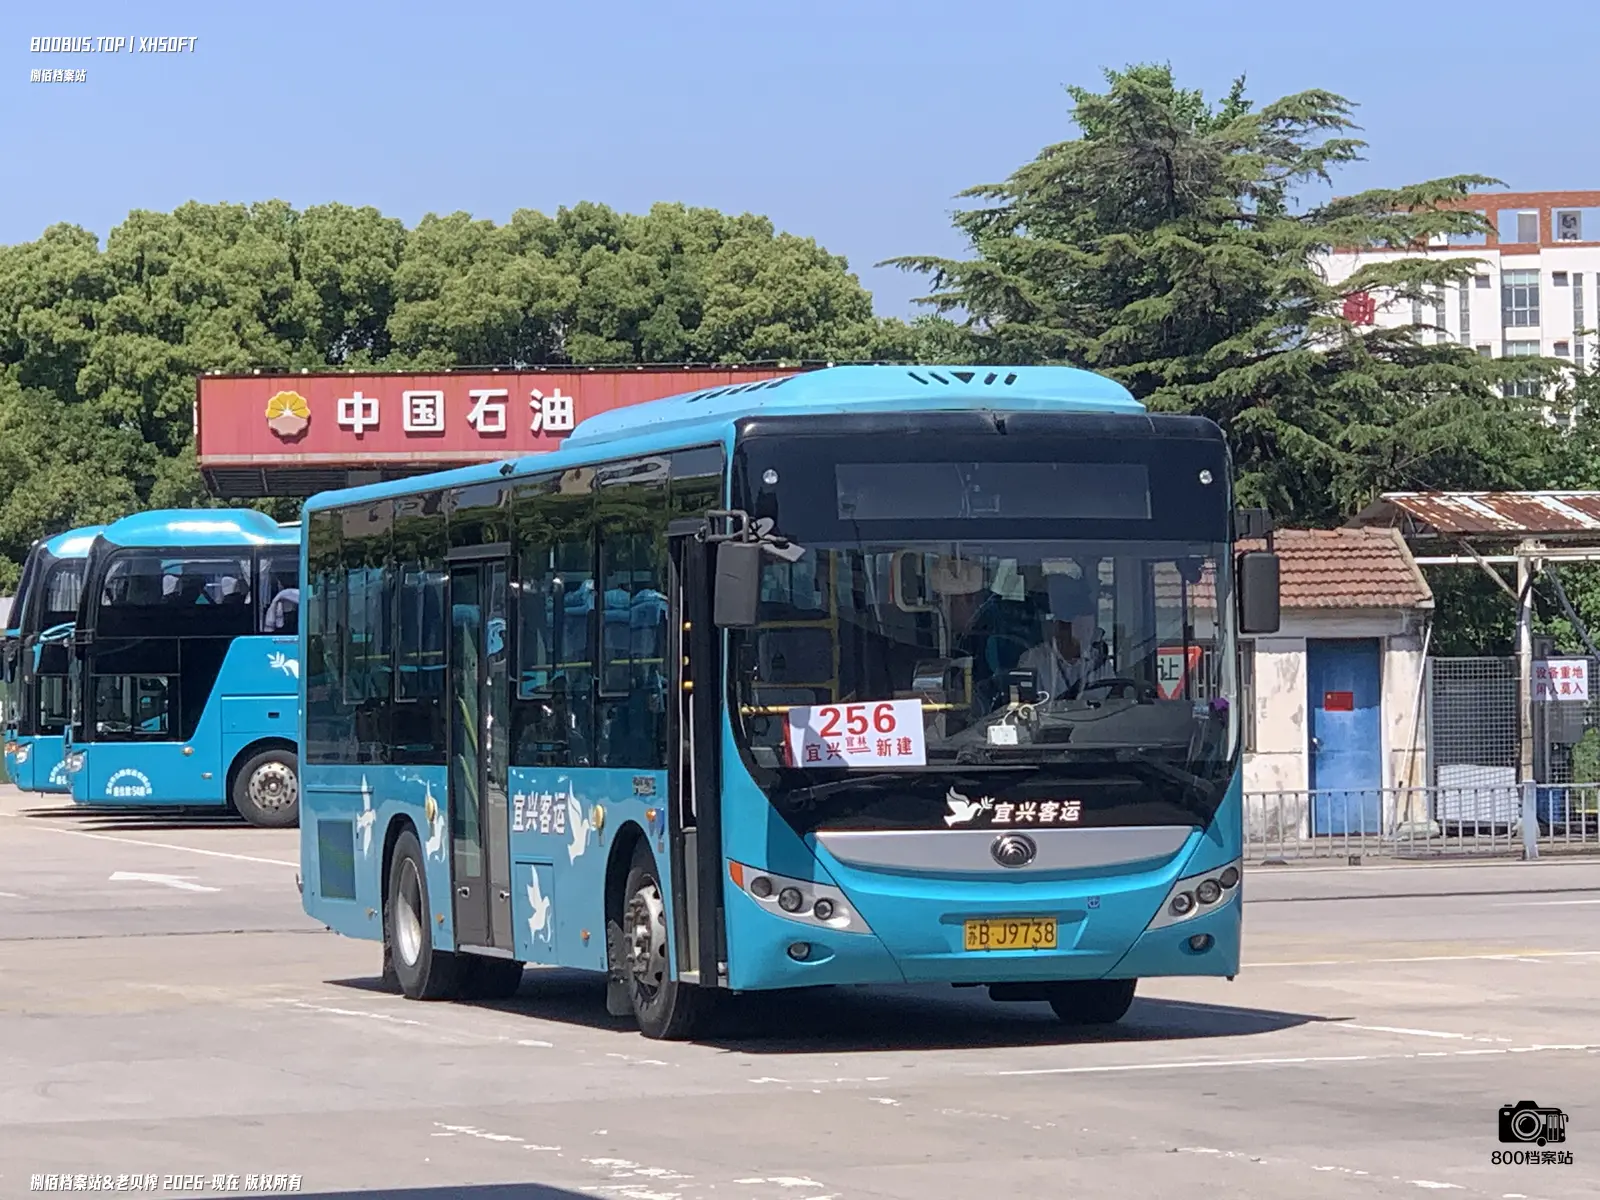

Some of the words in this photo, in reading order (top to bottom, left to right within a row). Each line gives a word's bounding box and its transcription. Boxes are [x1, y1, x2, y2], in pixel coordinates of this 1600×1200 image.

[336, 387, 576, 434] 中国石油
[819, 703, 896, 737] 256
[512, 789, 566, 834] 宜兴客运
[991, 800, 1081, 823] 宜兴客运
